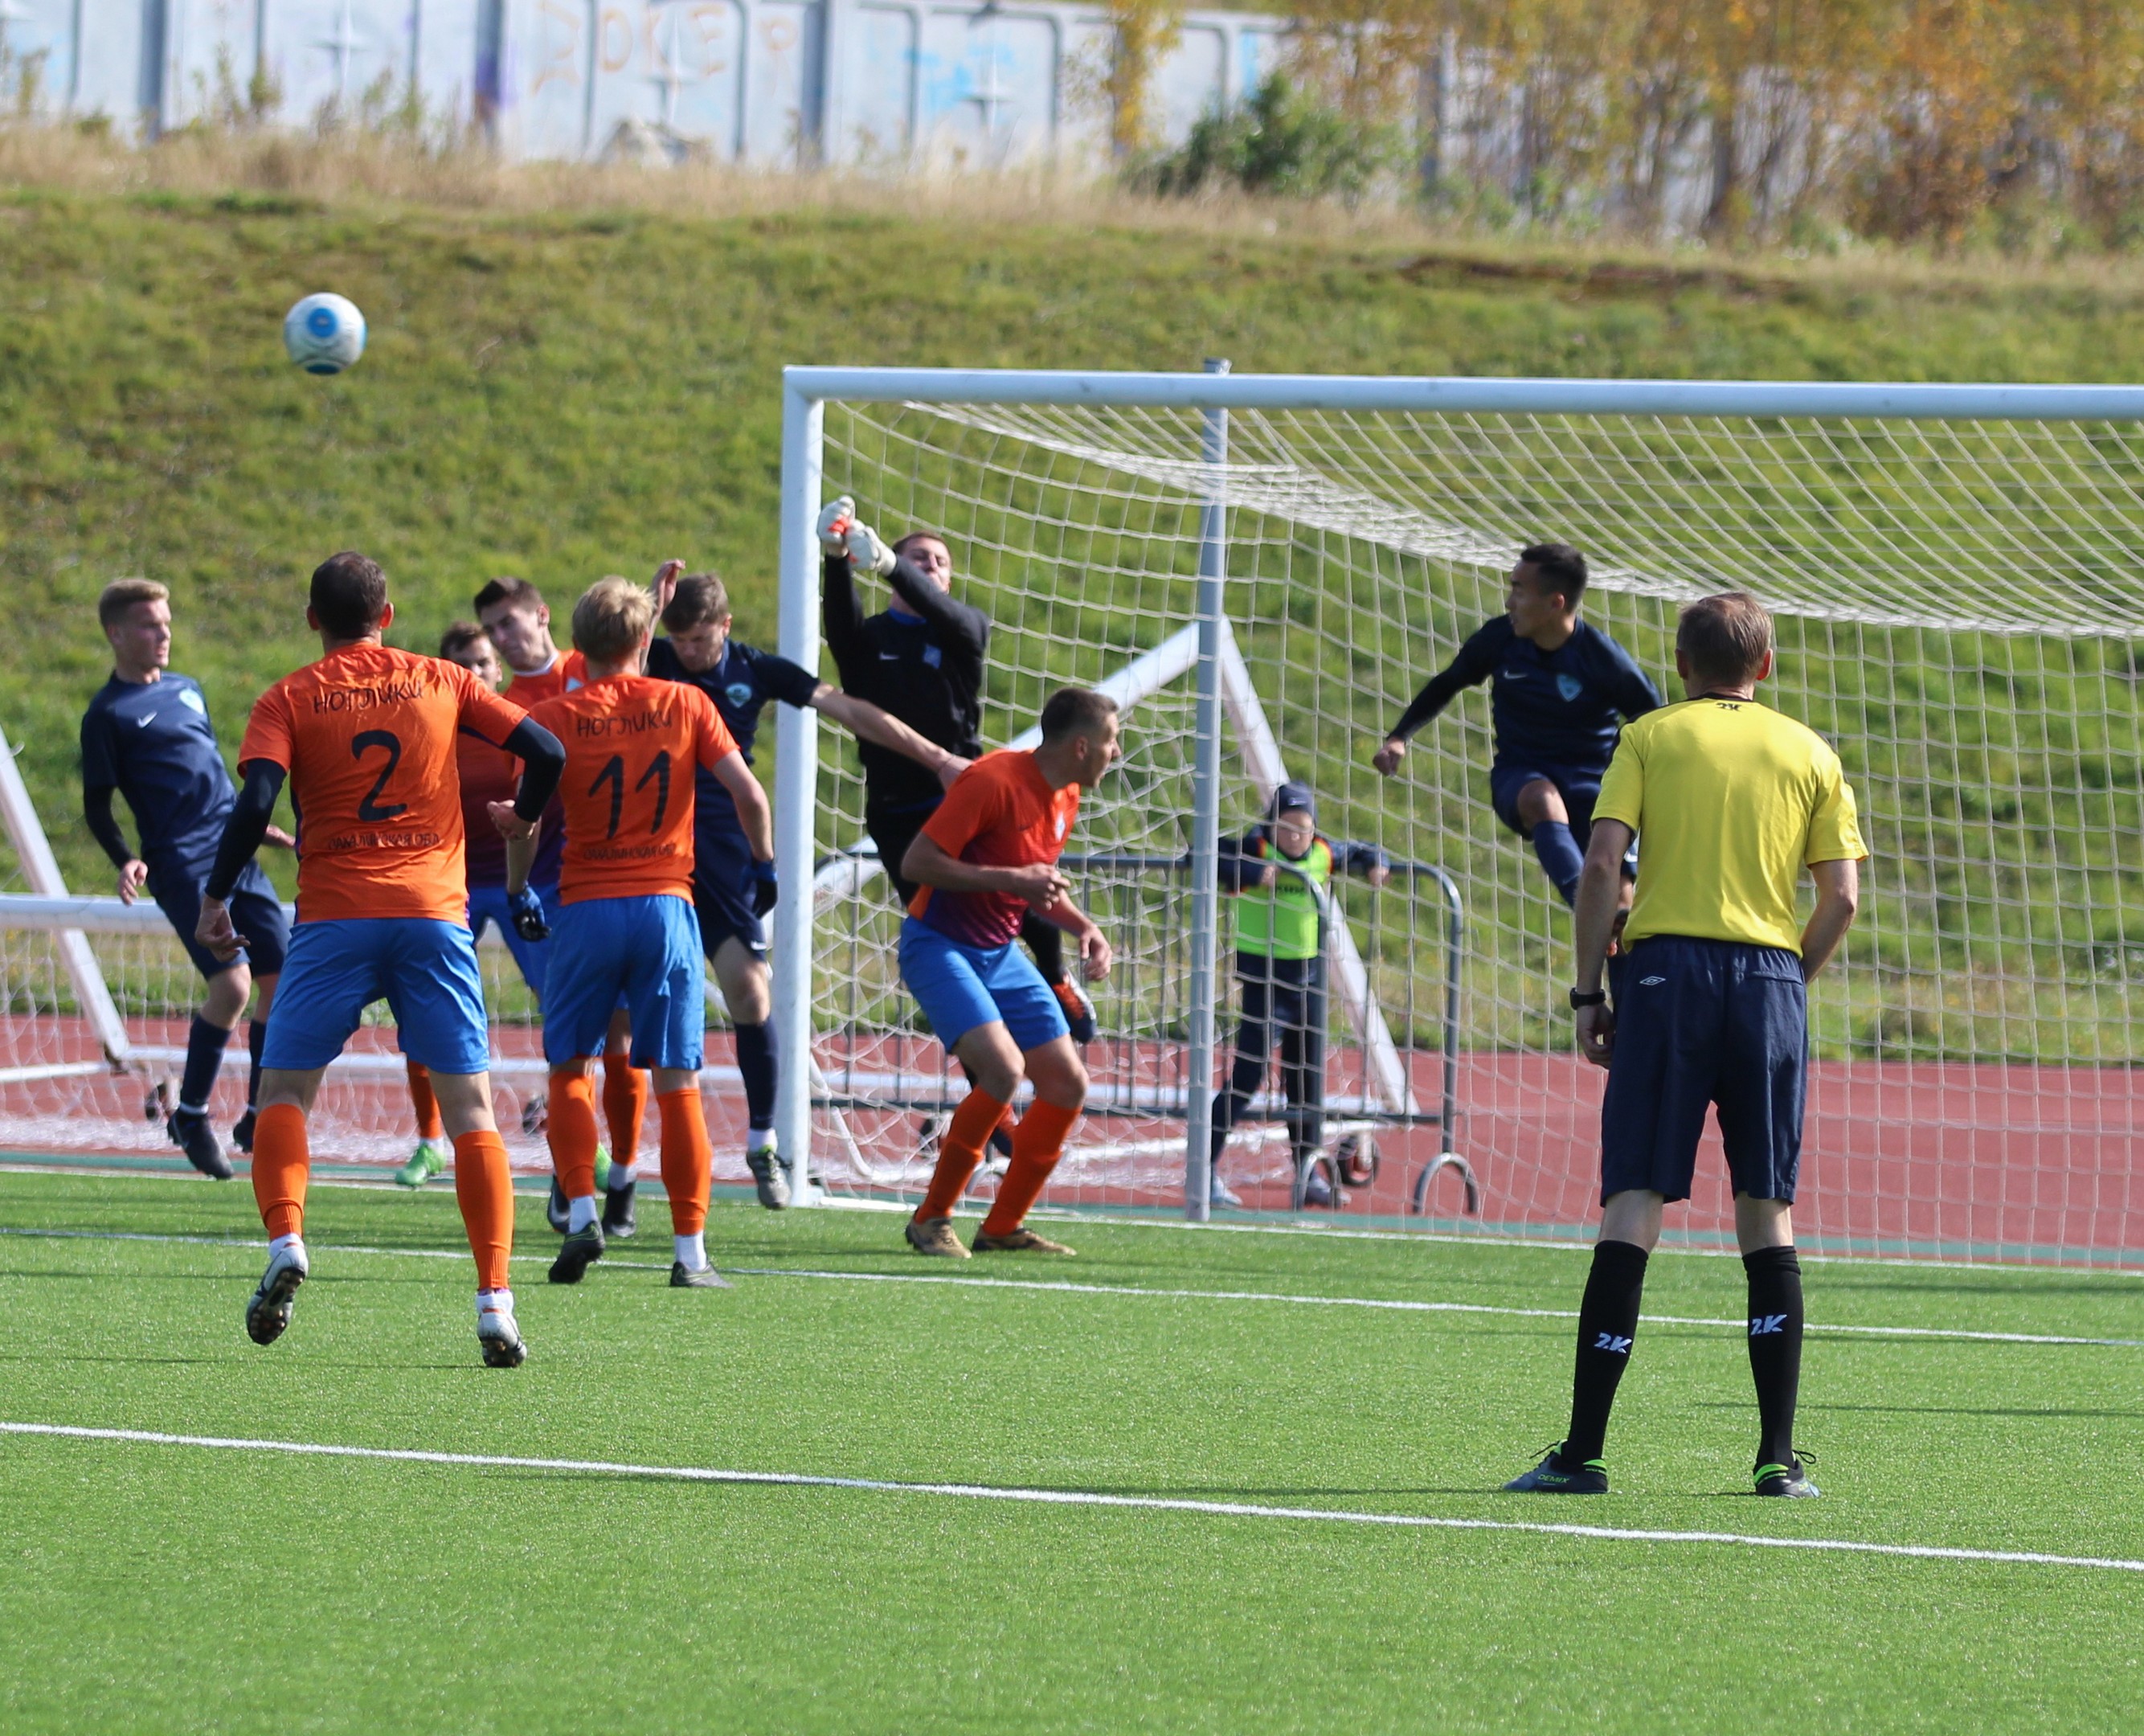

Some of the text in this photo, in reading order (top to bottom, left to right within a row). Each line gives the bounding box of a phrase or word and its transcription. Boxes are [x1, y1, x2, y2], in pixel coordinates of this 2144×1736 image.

[313, 681, 421, 714] НОГЛИКИ
[577, 708, 672, 738] НОГЛИКИ
[351, 729, 407, 822] 2
[587, 750, 670, 839] 11
[1594, 1332, 1633, 1354] 2K
[1537, 1473, 1569, 1484] DEMIX
